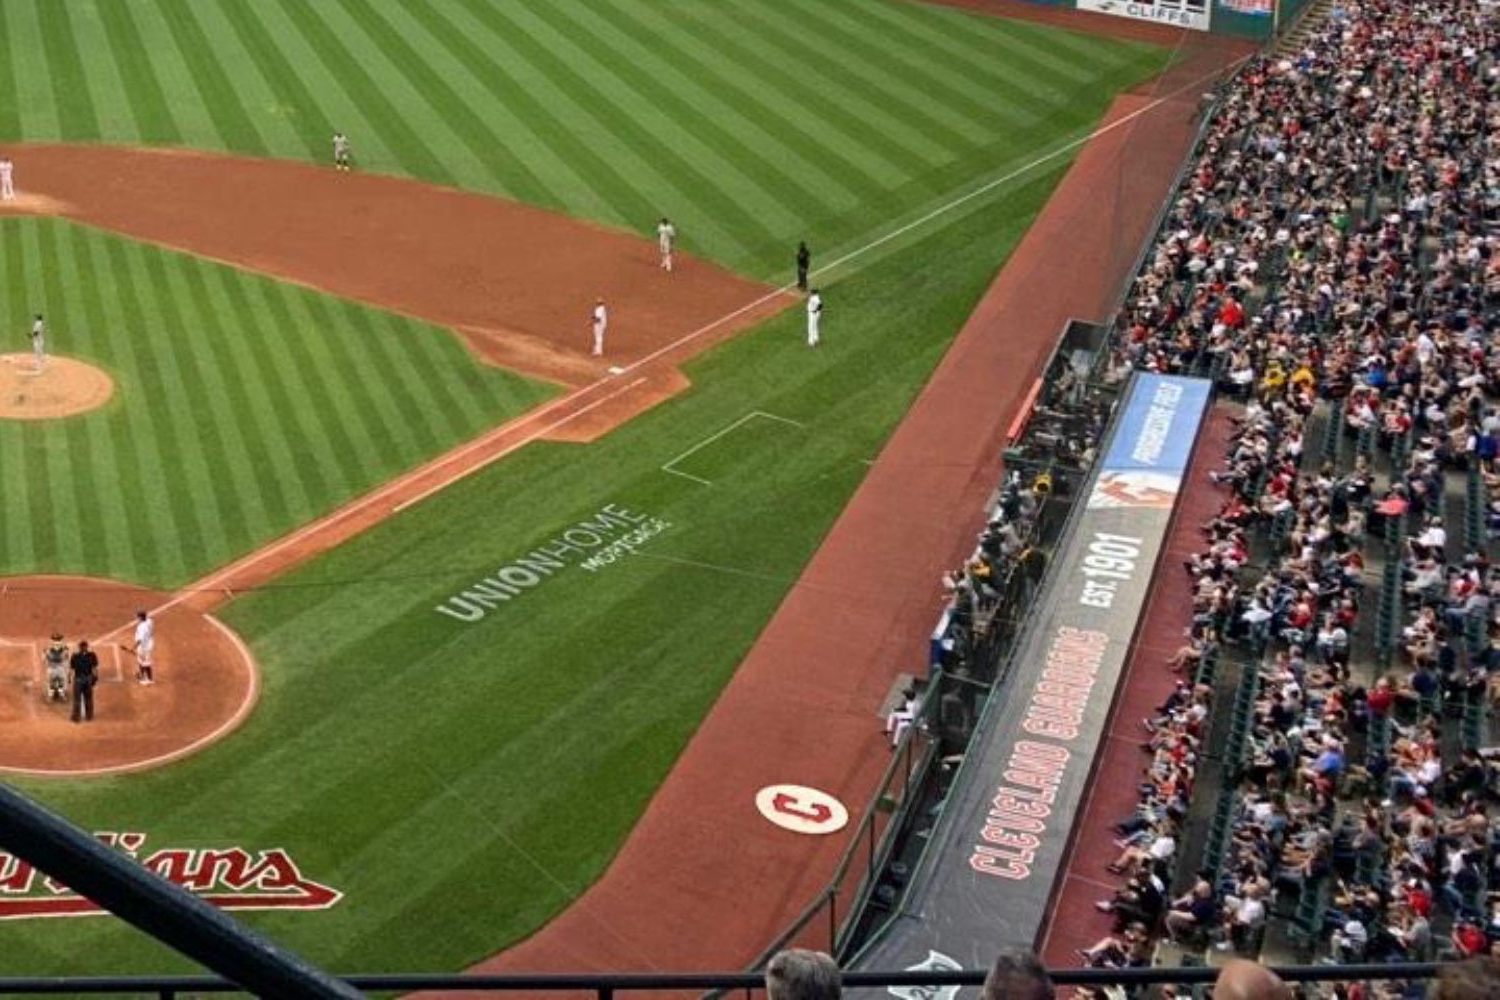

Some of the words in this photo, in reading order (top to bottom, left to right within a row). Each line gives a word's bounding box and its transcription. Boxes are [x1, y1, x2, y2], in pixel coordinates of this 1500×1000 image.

[1126, 3, 1191, 25] CLIFFS
[1083, 532, 1143, 582] 1901
[969, 739, 1071, 881] CLEVELAND
[1022, 624, 1109, 741] GUARDIANS
